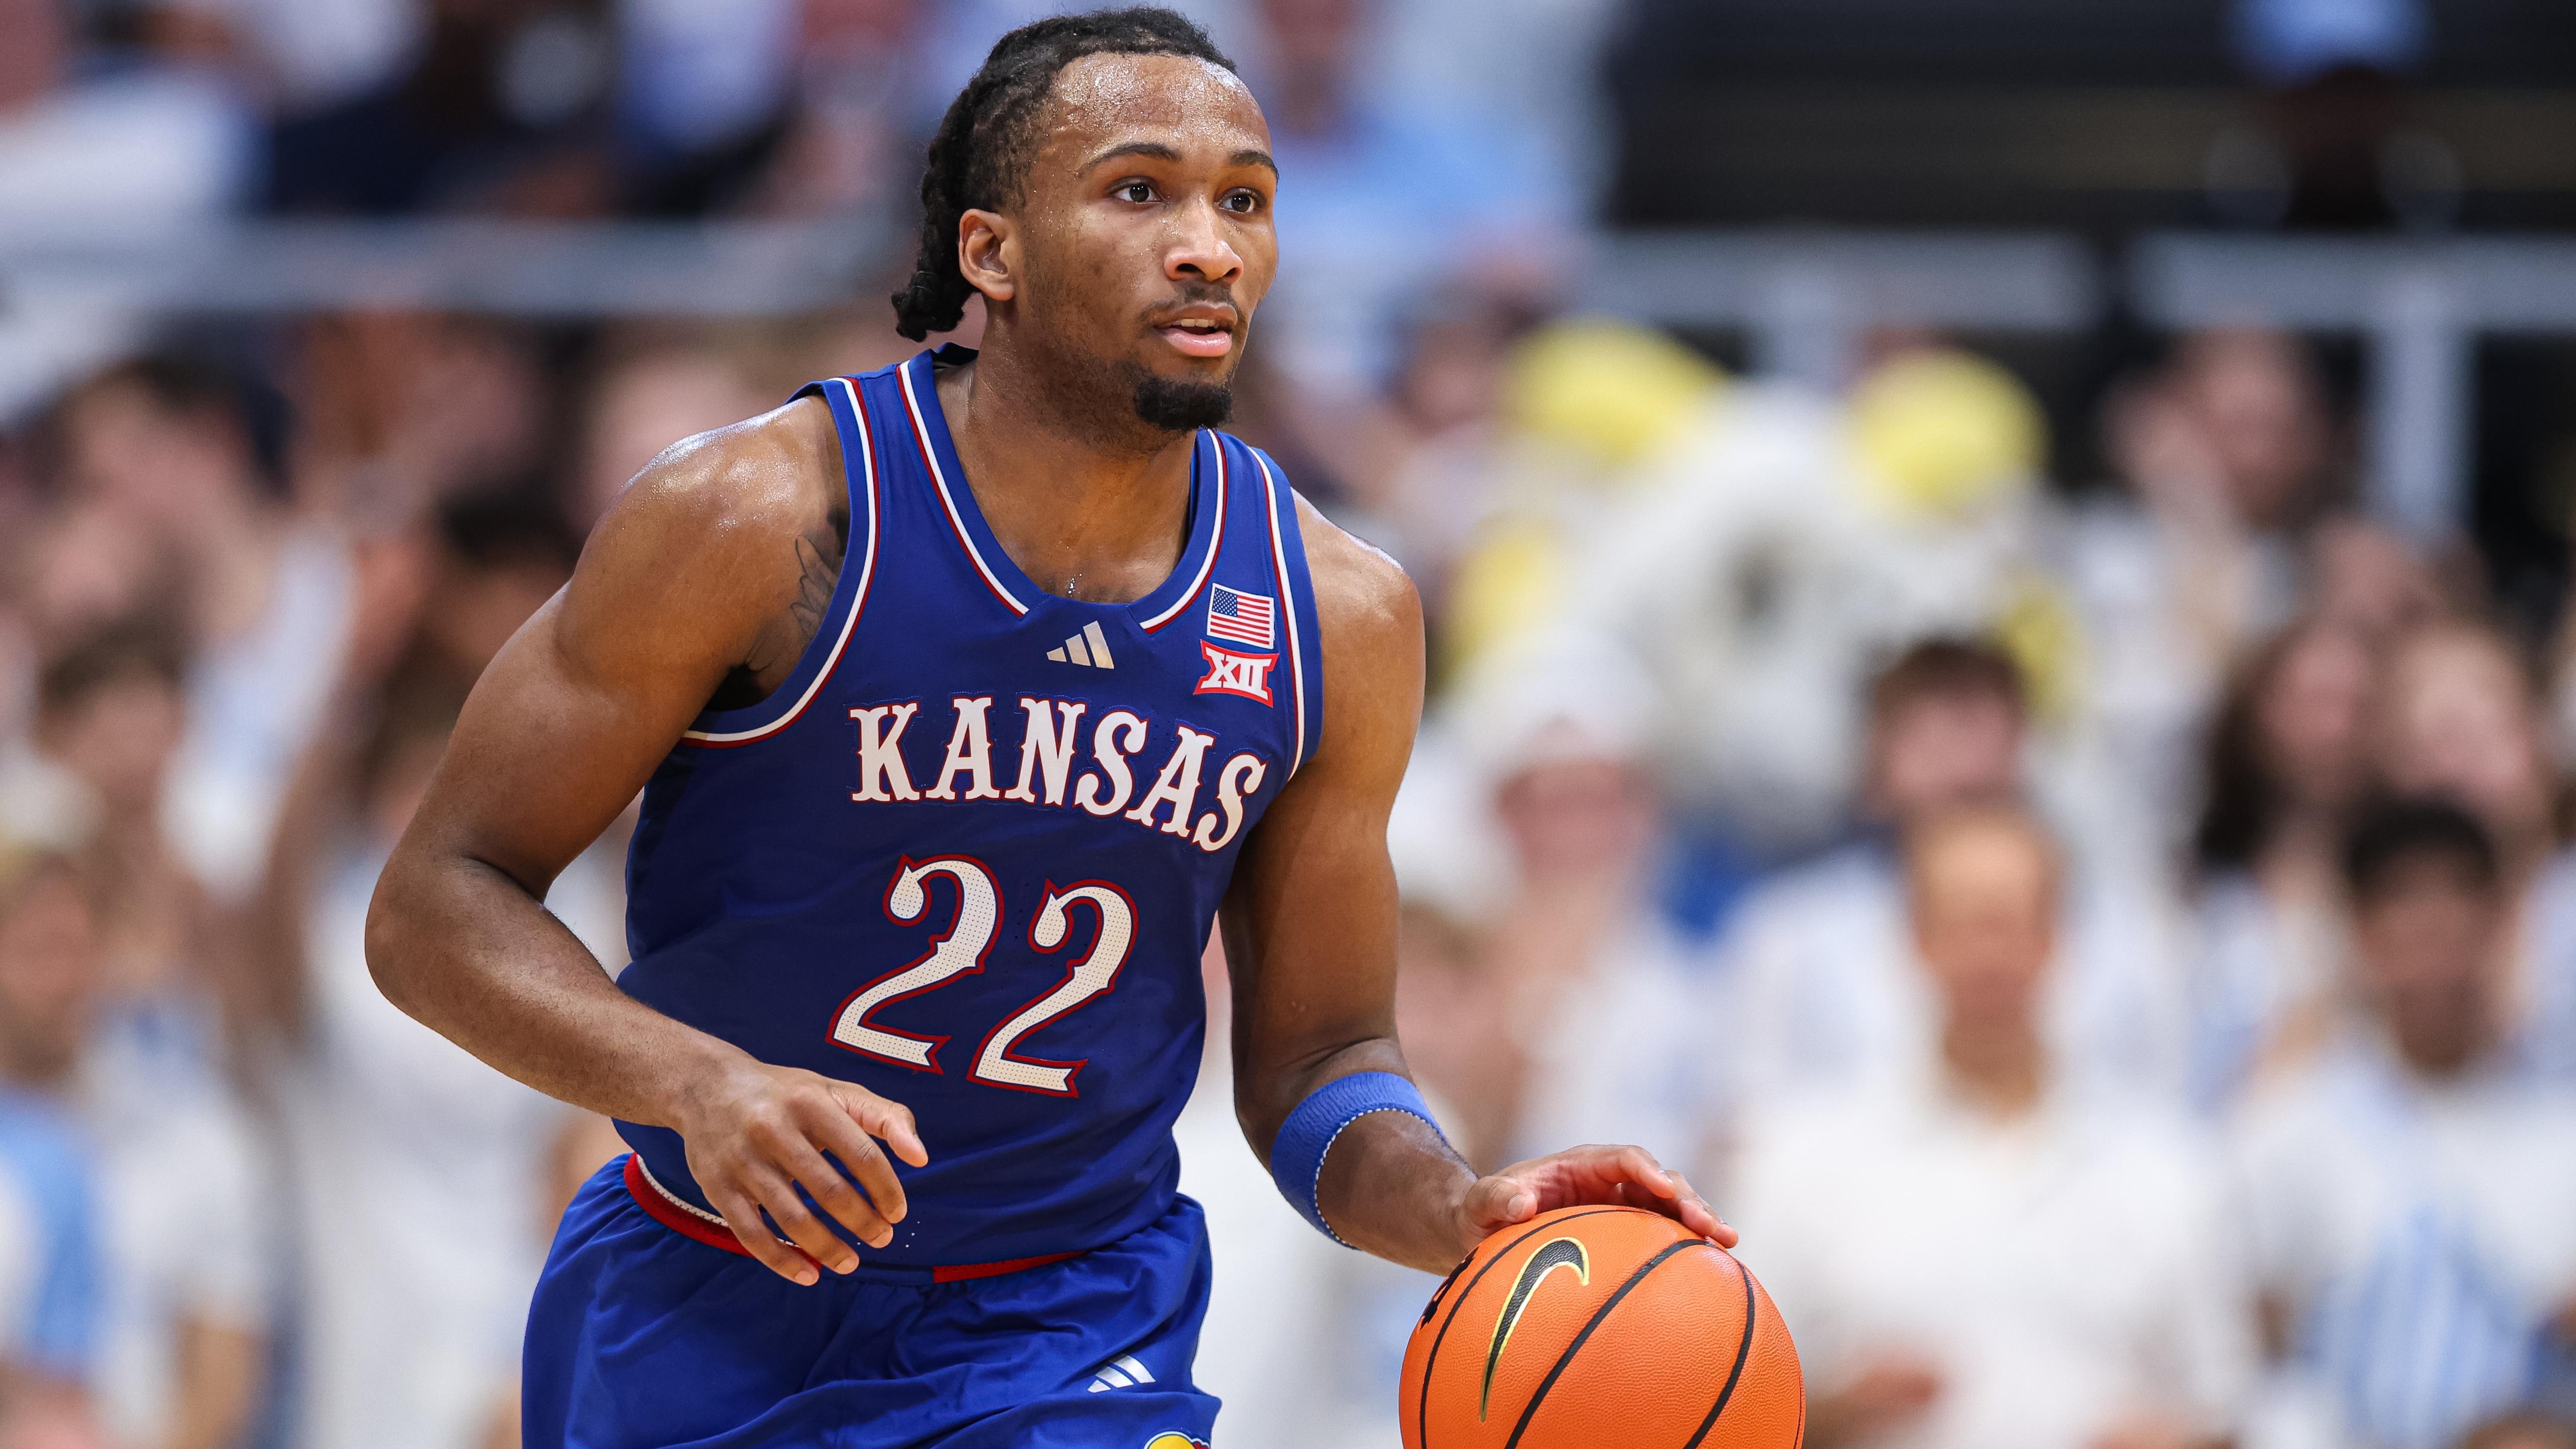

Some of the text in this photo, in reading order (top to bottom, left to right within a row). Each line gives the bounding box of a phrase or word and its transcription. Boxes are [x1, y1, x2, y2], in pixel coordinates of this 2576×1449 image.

[1200, 646, 1272, 701] XII
[849, 696, 1266, 853] KANSAS
[826, 855, 1139, 1097] 22
